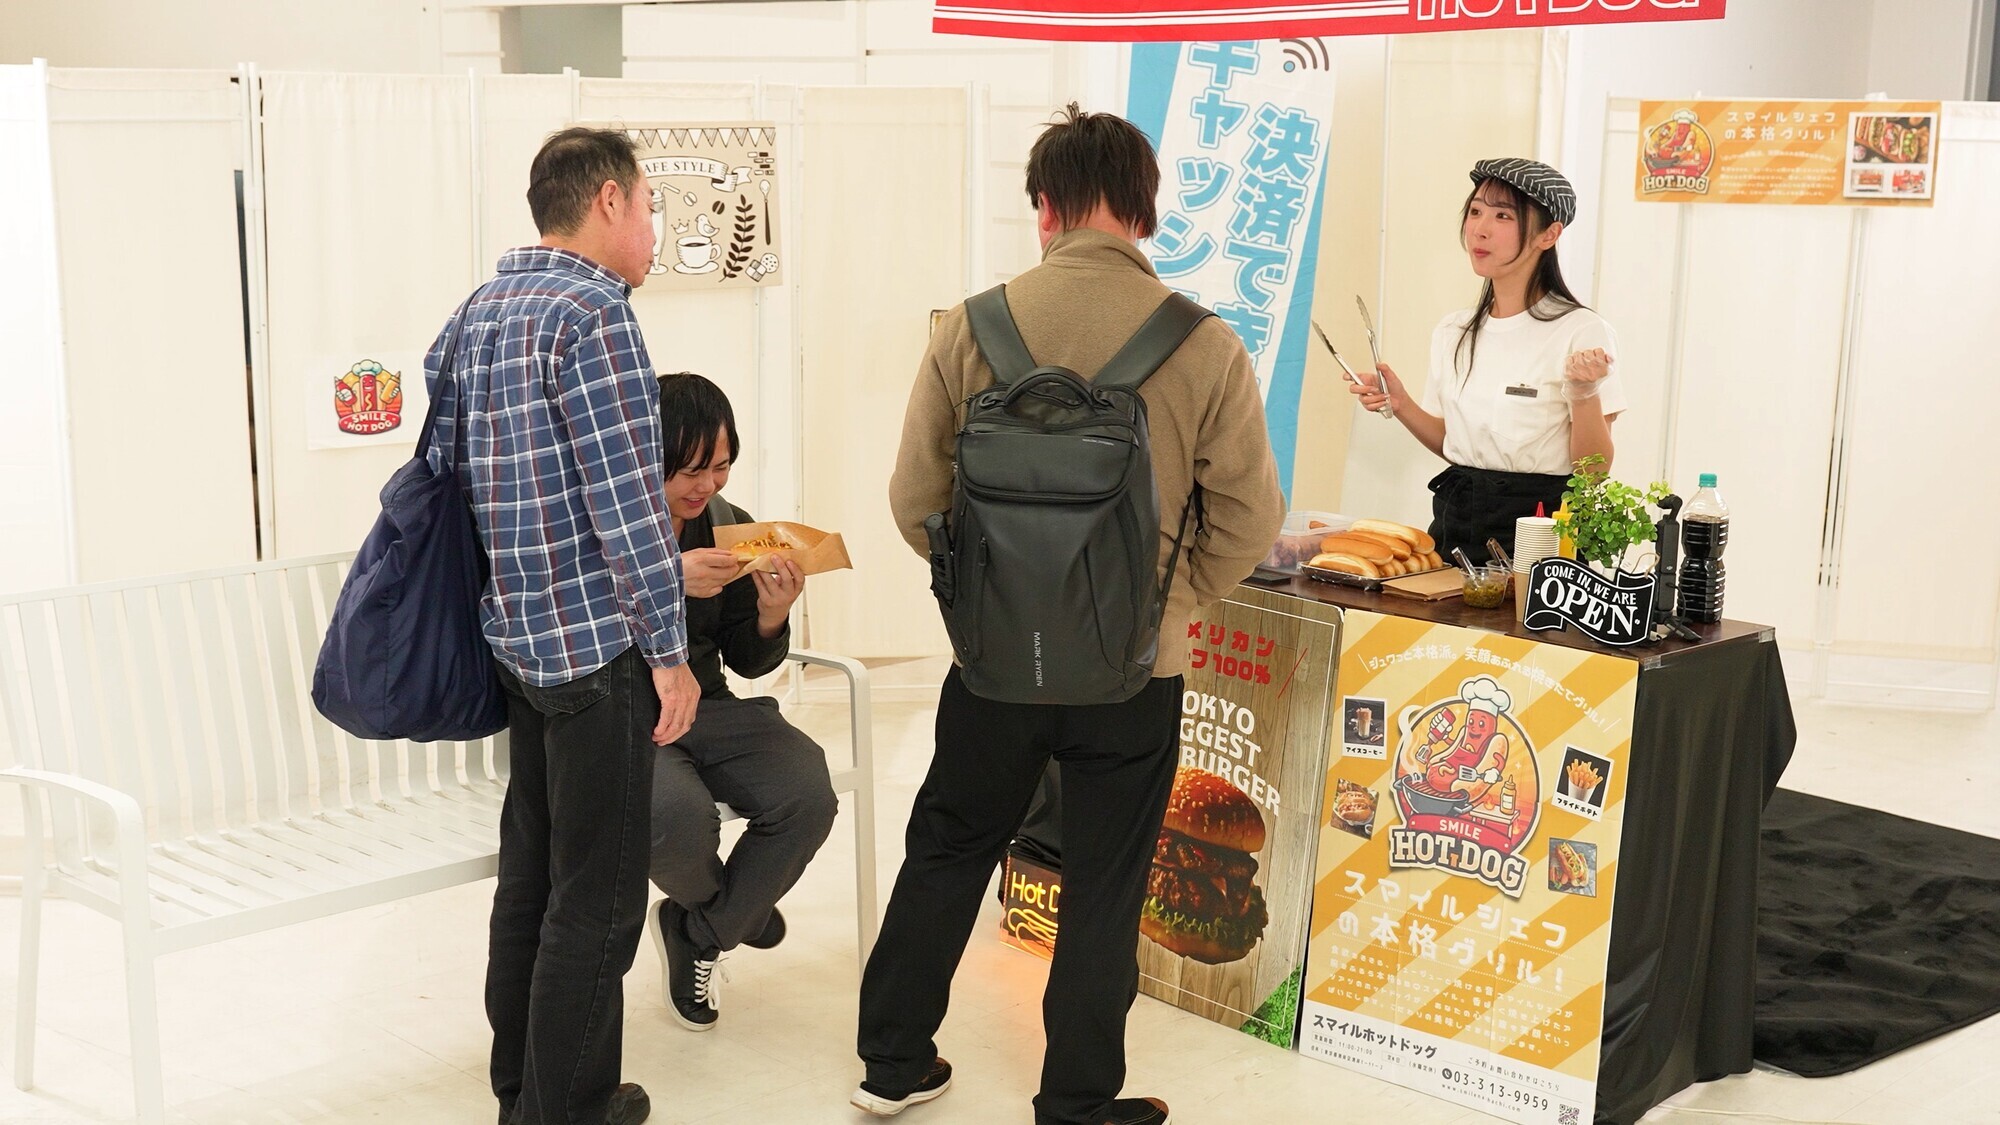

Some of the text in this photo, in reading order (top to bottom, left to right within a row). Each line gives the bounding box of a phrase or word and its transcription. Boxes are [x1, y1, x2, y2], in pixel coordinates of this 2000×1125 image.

[1726, 111, 1836, 124] スマイルシェフ
[645, 161, 716, 174] AFE STYLE
[347, 420, 393, 432] HOT DOG
[352, 412, 388, 423] SMILE
[1544, 565, 1637, 605] COME IN, WE ARE
[1540, 577, 1638, 636] OPEN
[1187, 621, 1275, 657] メリカン
[1033, 631, 1043, 687] MARK RYDEN
[1182, 690, 1255, 735] OKYO
[1345, 746, 1383, 756] アイスコーヒー
[1557, 797, 1598, 817] フライドポテト
[1439, 819, 1482, 840] SMILE
[1010, 871, 1047, 910] Hot
[1344, 870, 1567, 949] スマイルシェフ
[1313, 1014, 1438, 1059] スマイルホットドッグ
